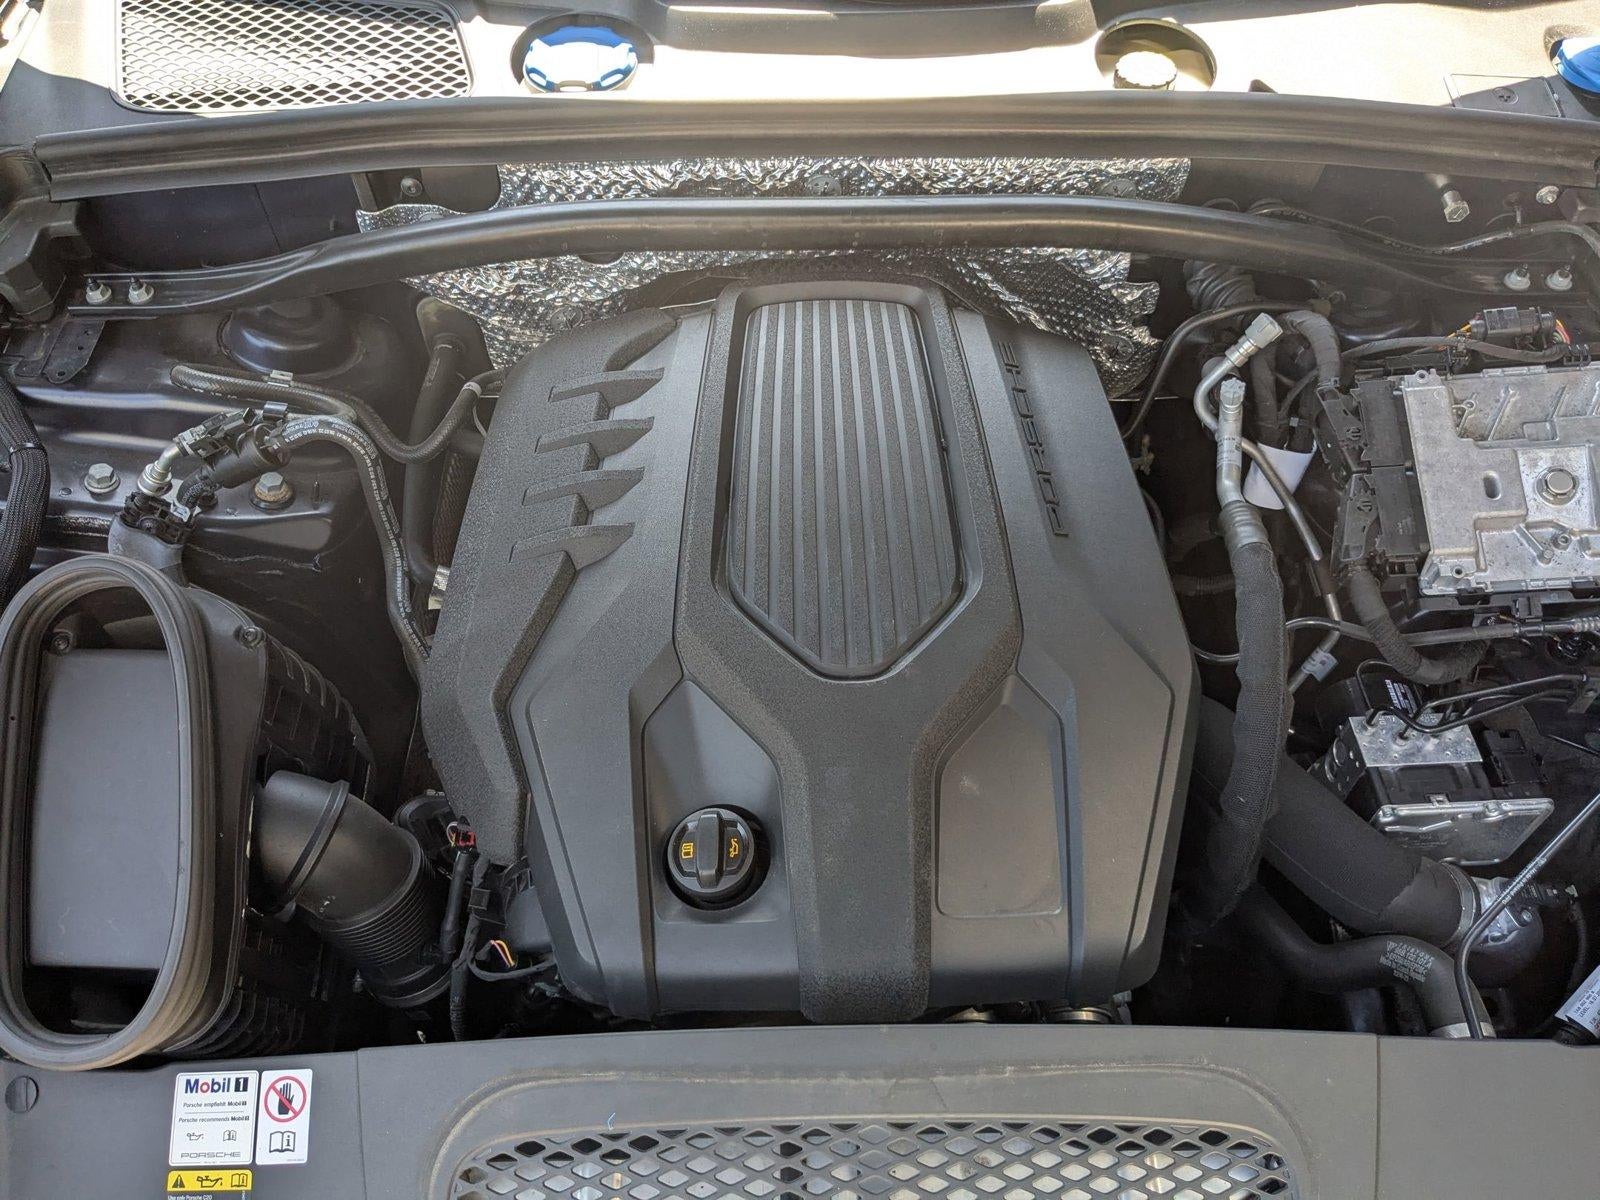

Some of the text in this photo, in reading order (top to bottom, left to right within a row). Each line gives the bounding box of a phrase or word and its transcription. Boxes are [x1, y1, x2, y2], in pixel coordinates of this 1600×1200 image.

[998, 341, 1069, 537] PORSCHE
[184, 1077, 247, 1094] Mobil 1
